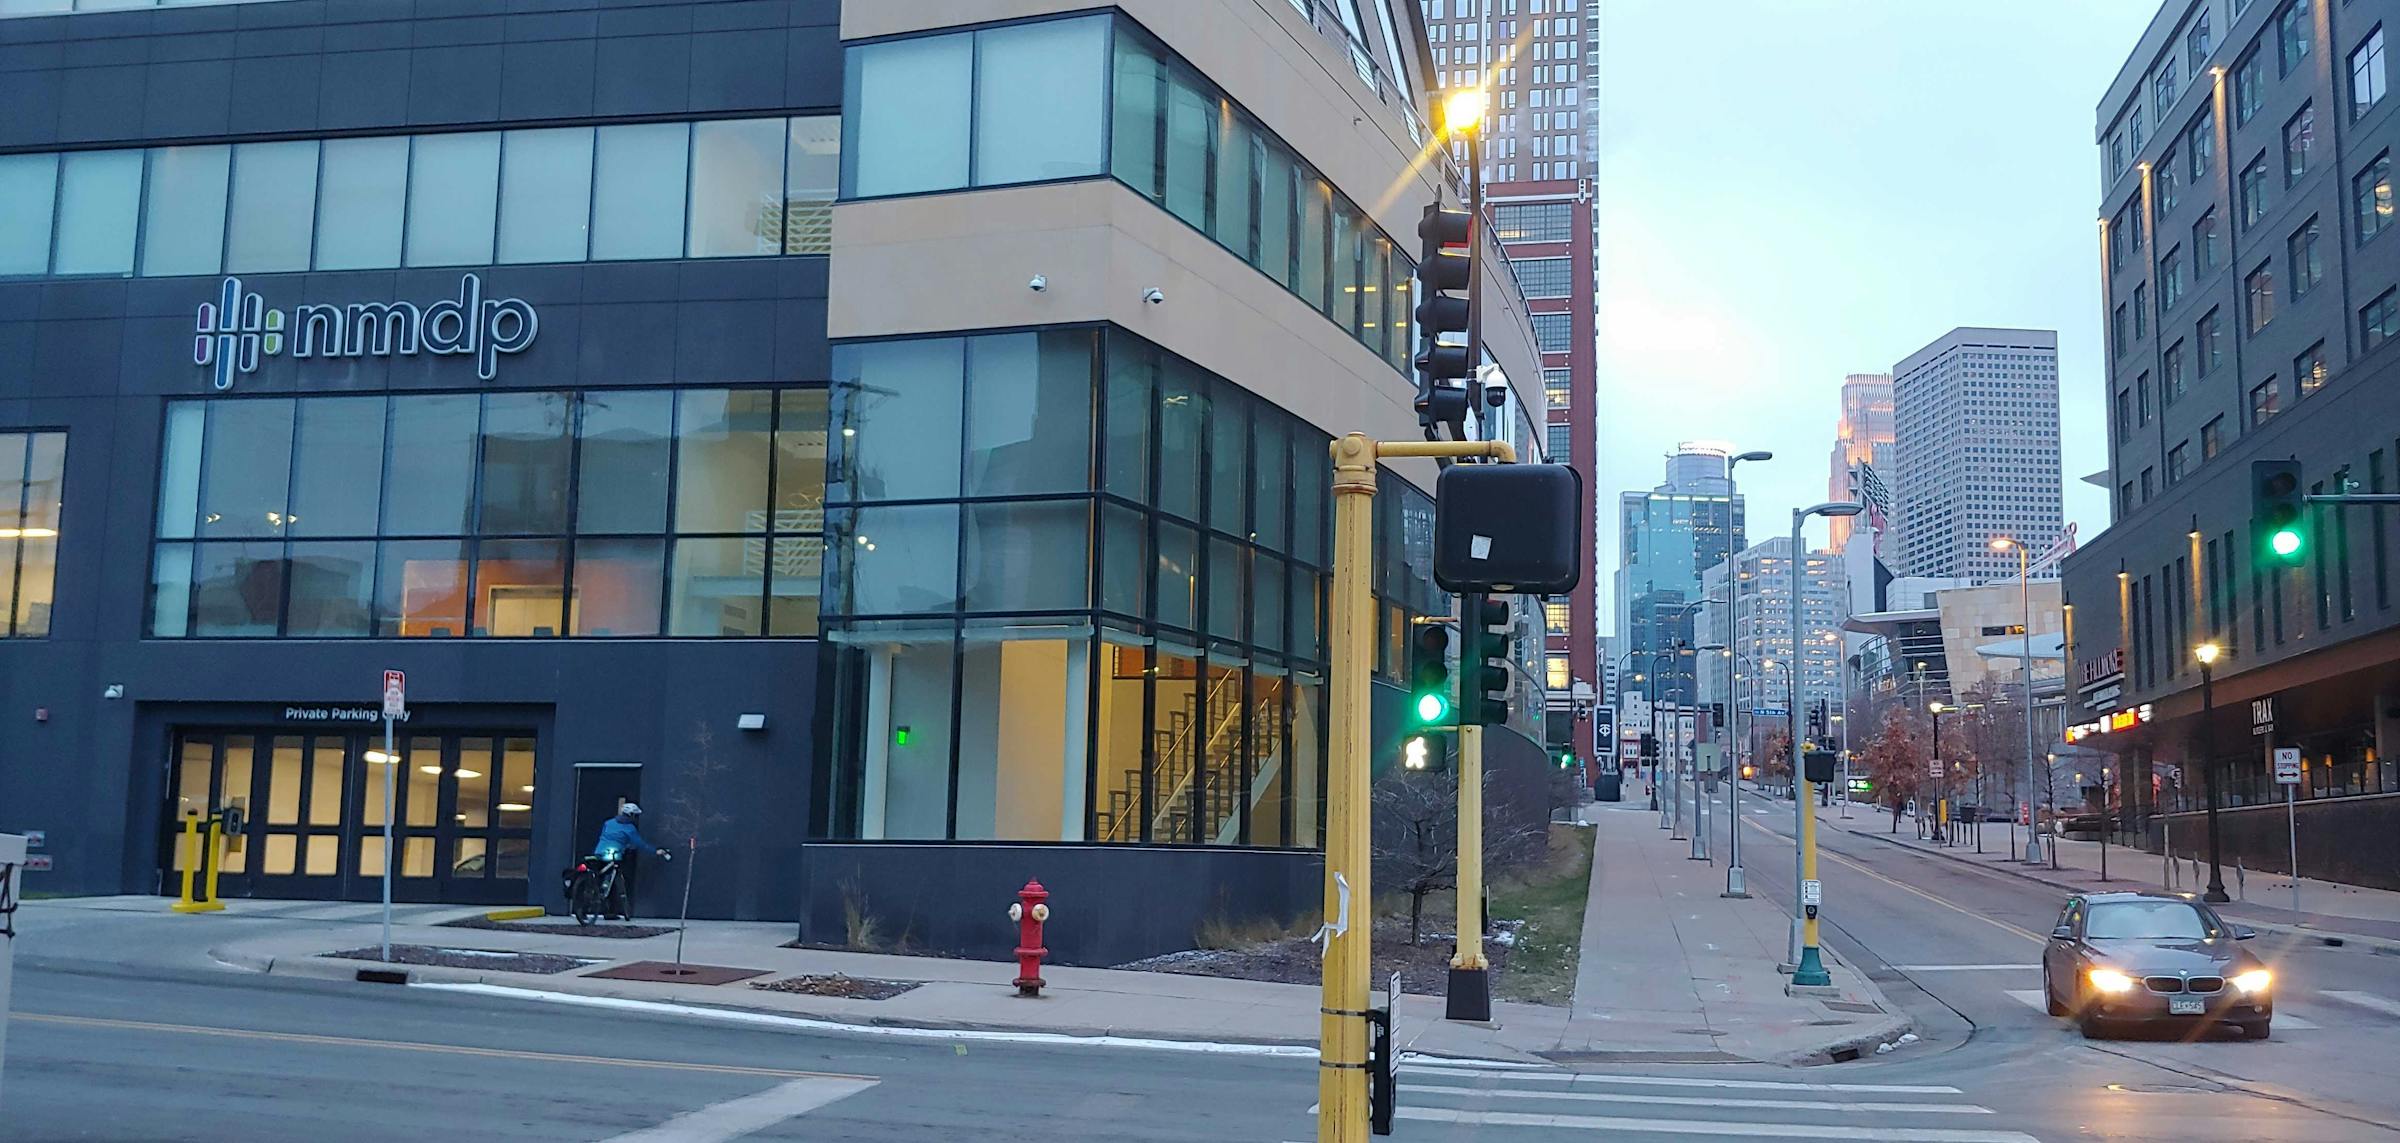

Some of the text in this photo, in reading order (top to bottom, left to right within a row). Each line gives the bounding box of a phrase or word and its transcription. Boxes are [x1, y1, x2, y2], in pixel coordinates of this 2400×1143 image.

[293, 273, 539, 381] nmdp
[286, 707, 329, 720] Private
[332, 708, 378, 722] Parking
[2252, 697, 2273, 725] TRAX
[2282, 751, 2293, 760] NO
